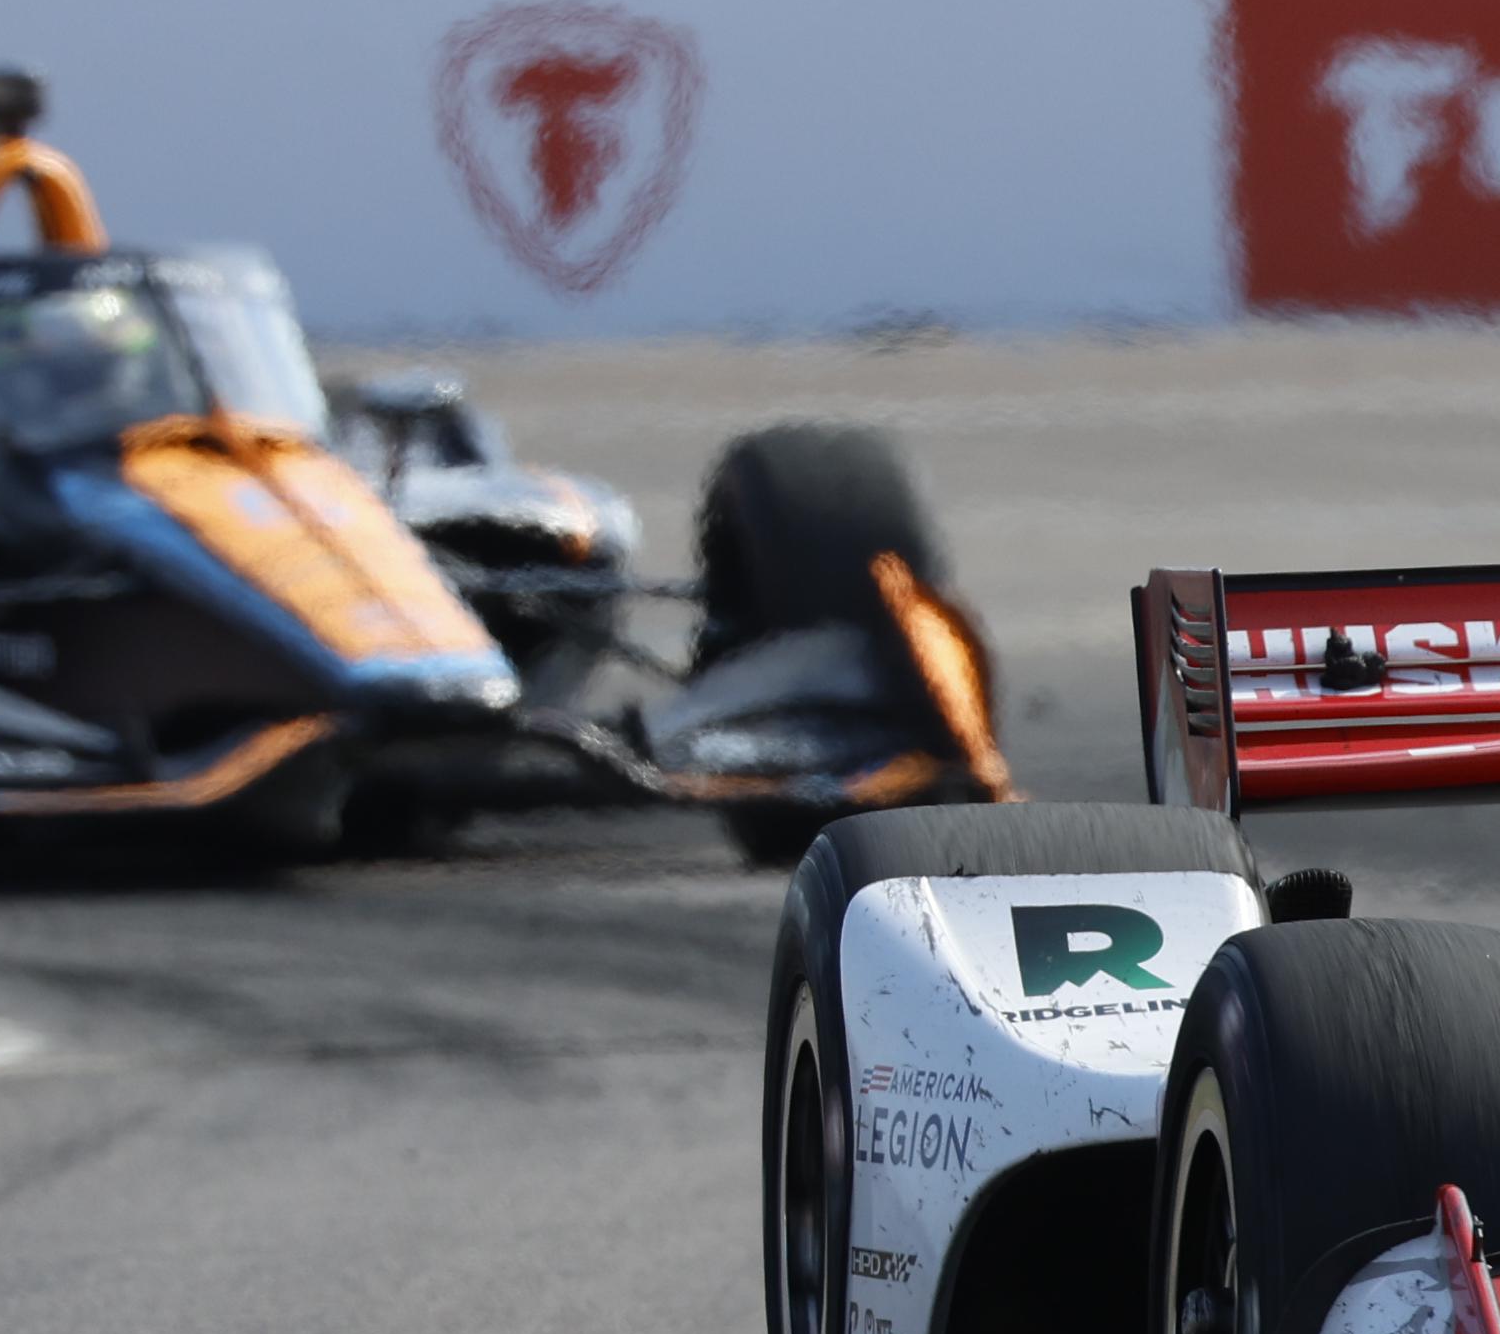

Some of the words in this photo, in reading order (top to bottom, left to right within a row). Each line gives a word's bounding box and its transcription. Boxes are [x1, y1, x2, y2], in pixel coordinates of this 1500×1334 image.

[1010, 904, 1176, 997] R
[889, 1071, 982, 1103] AMERICAN
[855, 1105, 974, 1171] LEGION
[851, 1250, 882, 1276] HPD
